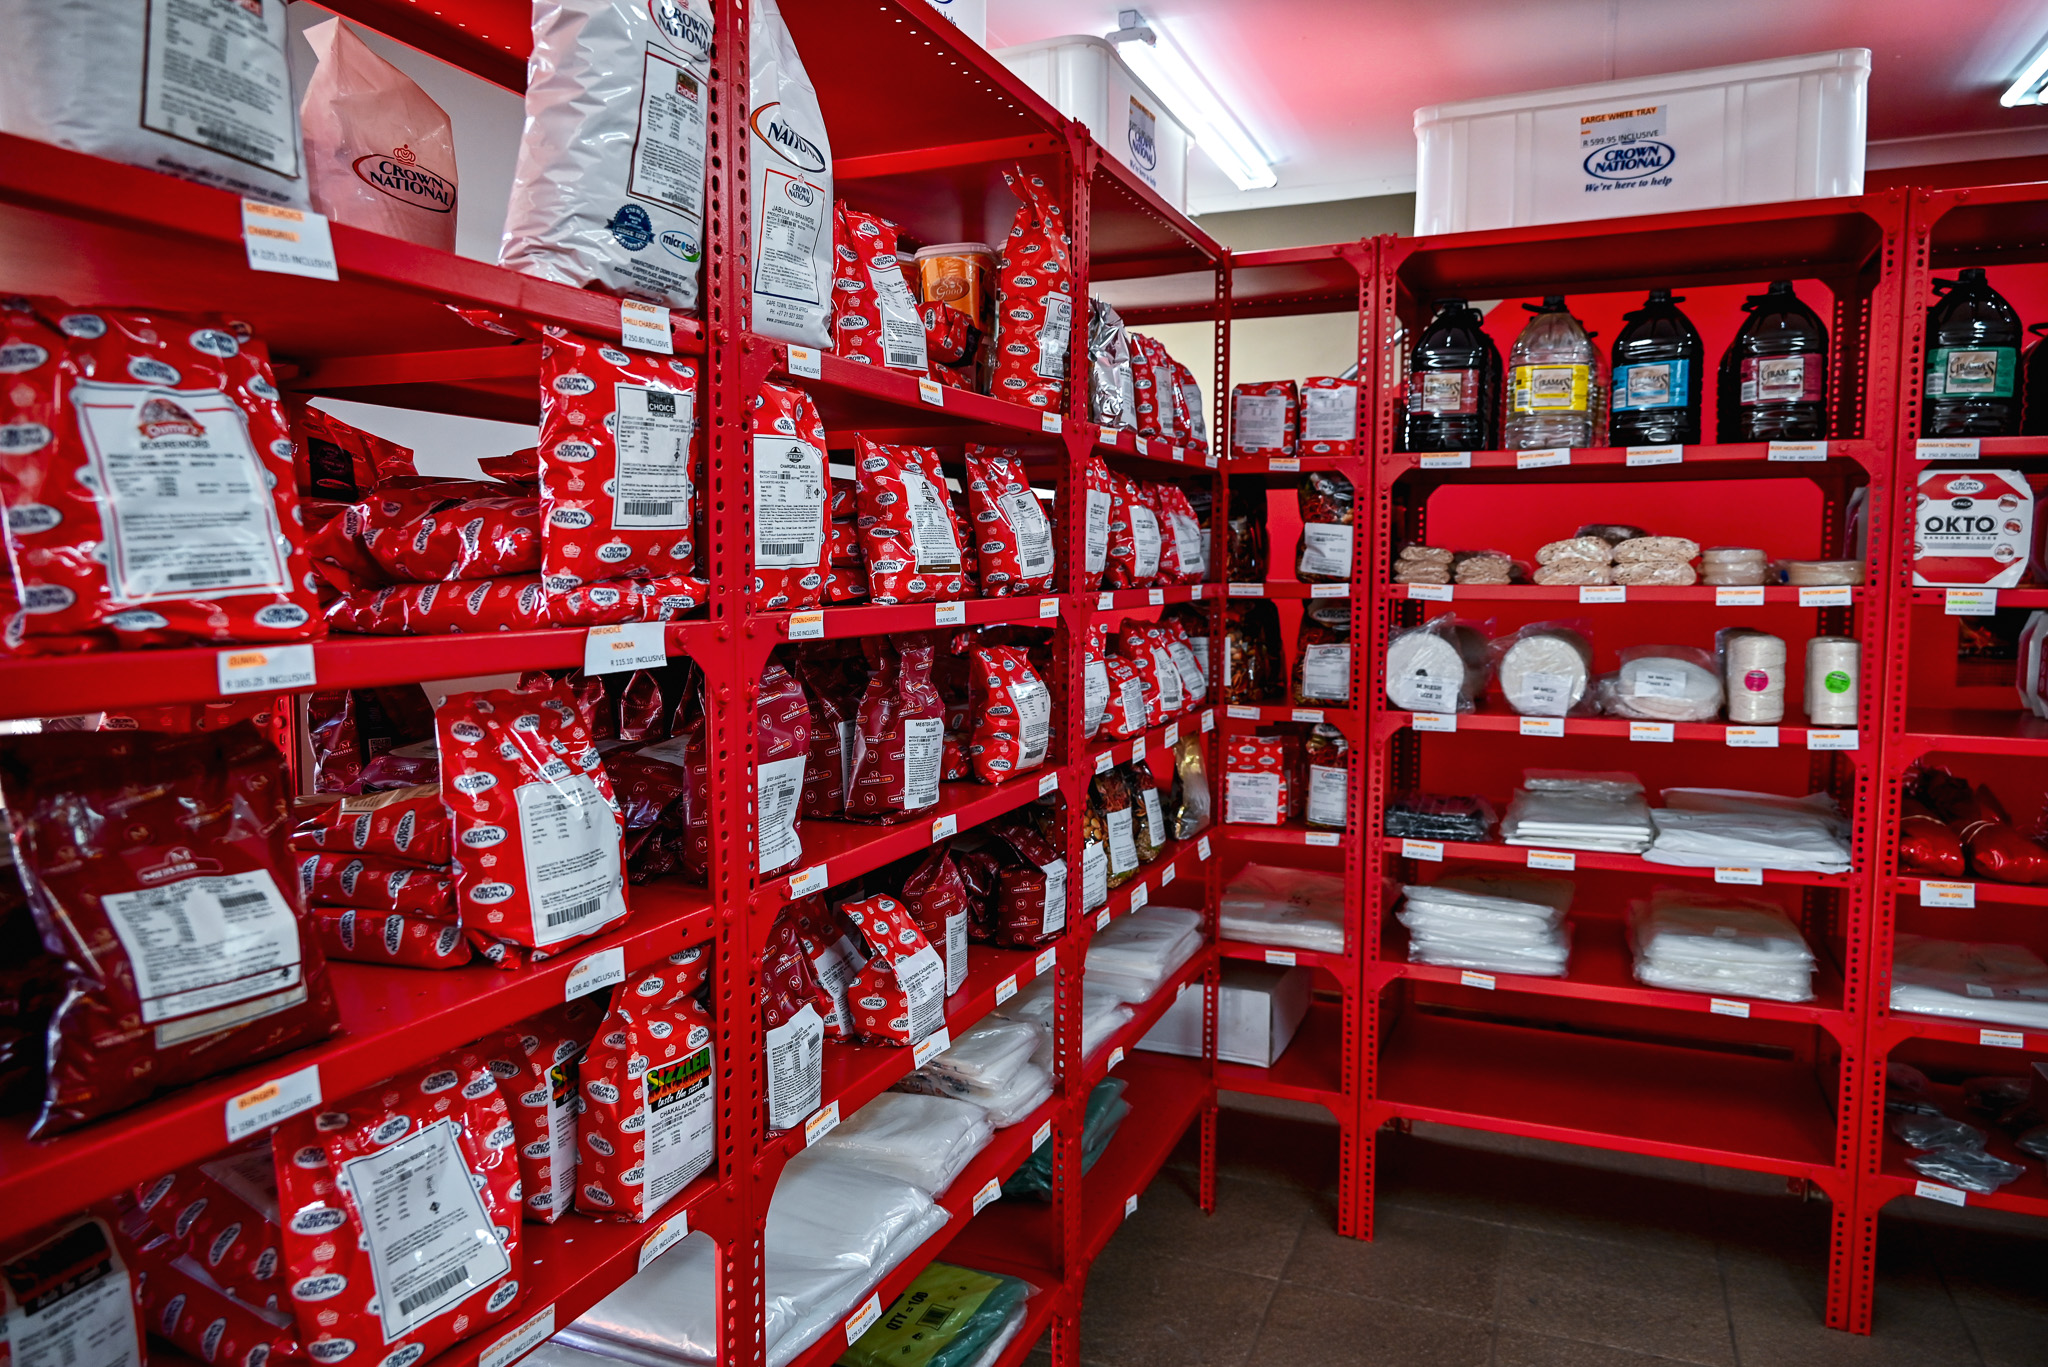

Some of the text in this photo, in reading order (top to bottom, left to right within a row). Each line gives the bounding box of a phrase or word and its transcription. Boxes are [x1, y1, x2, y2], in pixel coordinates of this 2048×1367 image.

[677, 84, 698, 103] CHOICE
[1581, 107, 1657, 124] LARGE WHITE TRAY
[1590, 136, 1616, 146] 599.95
[1618, 129, 1659, 141] INCLUSIVE
[1604, 145, 1659, 161] CROWN
[1595, 156, 1664, 173] NATIONAL
[379, 160, 443, 189] CROWN
[370, 171, 450, 206] NATIONAL
[792, 183, 810, 196] CROWN
[1585, 176, 1672, 192] We're here to help
[788, 188, 811, 204] NATIONAL
[624, 301, 656, 314] CHIEF CHOICE
[624, 317, 664, 332] CHILLI CHARGRILL
[629, 335, 646, 344] 250.80
[646, 338, 669, 349] INCLUSIVE
[556, 383, 590, 391] NATIONAL
[648, 404, 674, 412] CHOICE
[551, 516, 587, 525] NATIONAL
[1925, 516, 1995, 533] OKTO
[603, 625, 622, 634] CHOICE
[636, 654, 664, 663] INCLUSIVE
[454, 728, 481, 739] NATIONAL
[457, 722, 480, 733] CROWN
[464, 833, 502, 844] NATIONAL
[468, 828, 497, 838] CROWN
[472, 890, 509, 900] NATIONAL
[476, 885, 505, 895] CROWN
[592, 970, 620, 985] INCLUSIVE
[639, 984, 663, 994] NATIONAL
[647, 1047, 710, 1092] SIZZLER
[590, 1090, 618, 1102] NATIONAL
[593, 1084, 616, 1095] CROWN
[658, 1093, 673, 1107] taste
[676, 1088, 686, 1100] the
[660, 1092, 706, 1118] CHAKALAKA WORS
[297, 1216, 344, 1229] NATIONAL
[304, 1210, 335, 1222] CROWN
[659, 1230, 680, 1250] INCLUSIVE
[297, 1284, 340, 1296] NATIONAL
[300, 1278, 338, 1289] CROWN
[519, 1308, 553, 1336] BOEREWORS
[886, 1312, 907, 1330] QTY
[514, 1330, 542, 1356] INCLUSIVE
